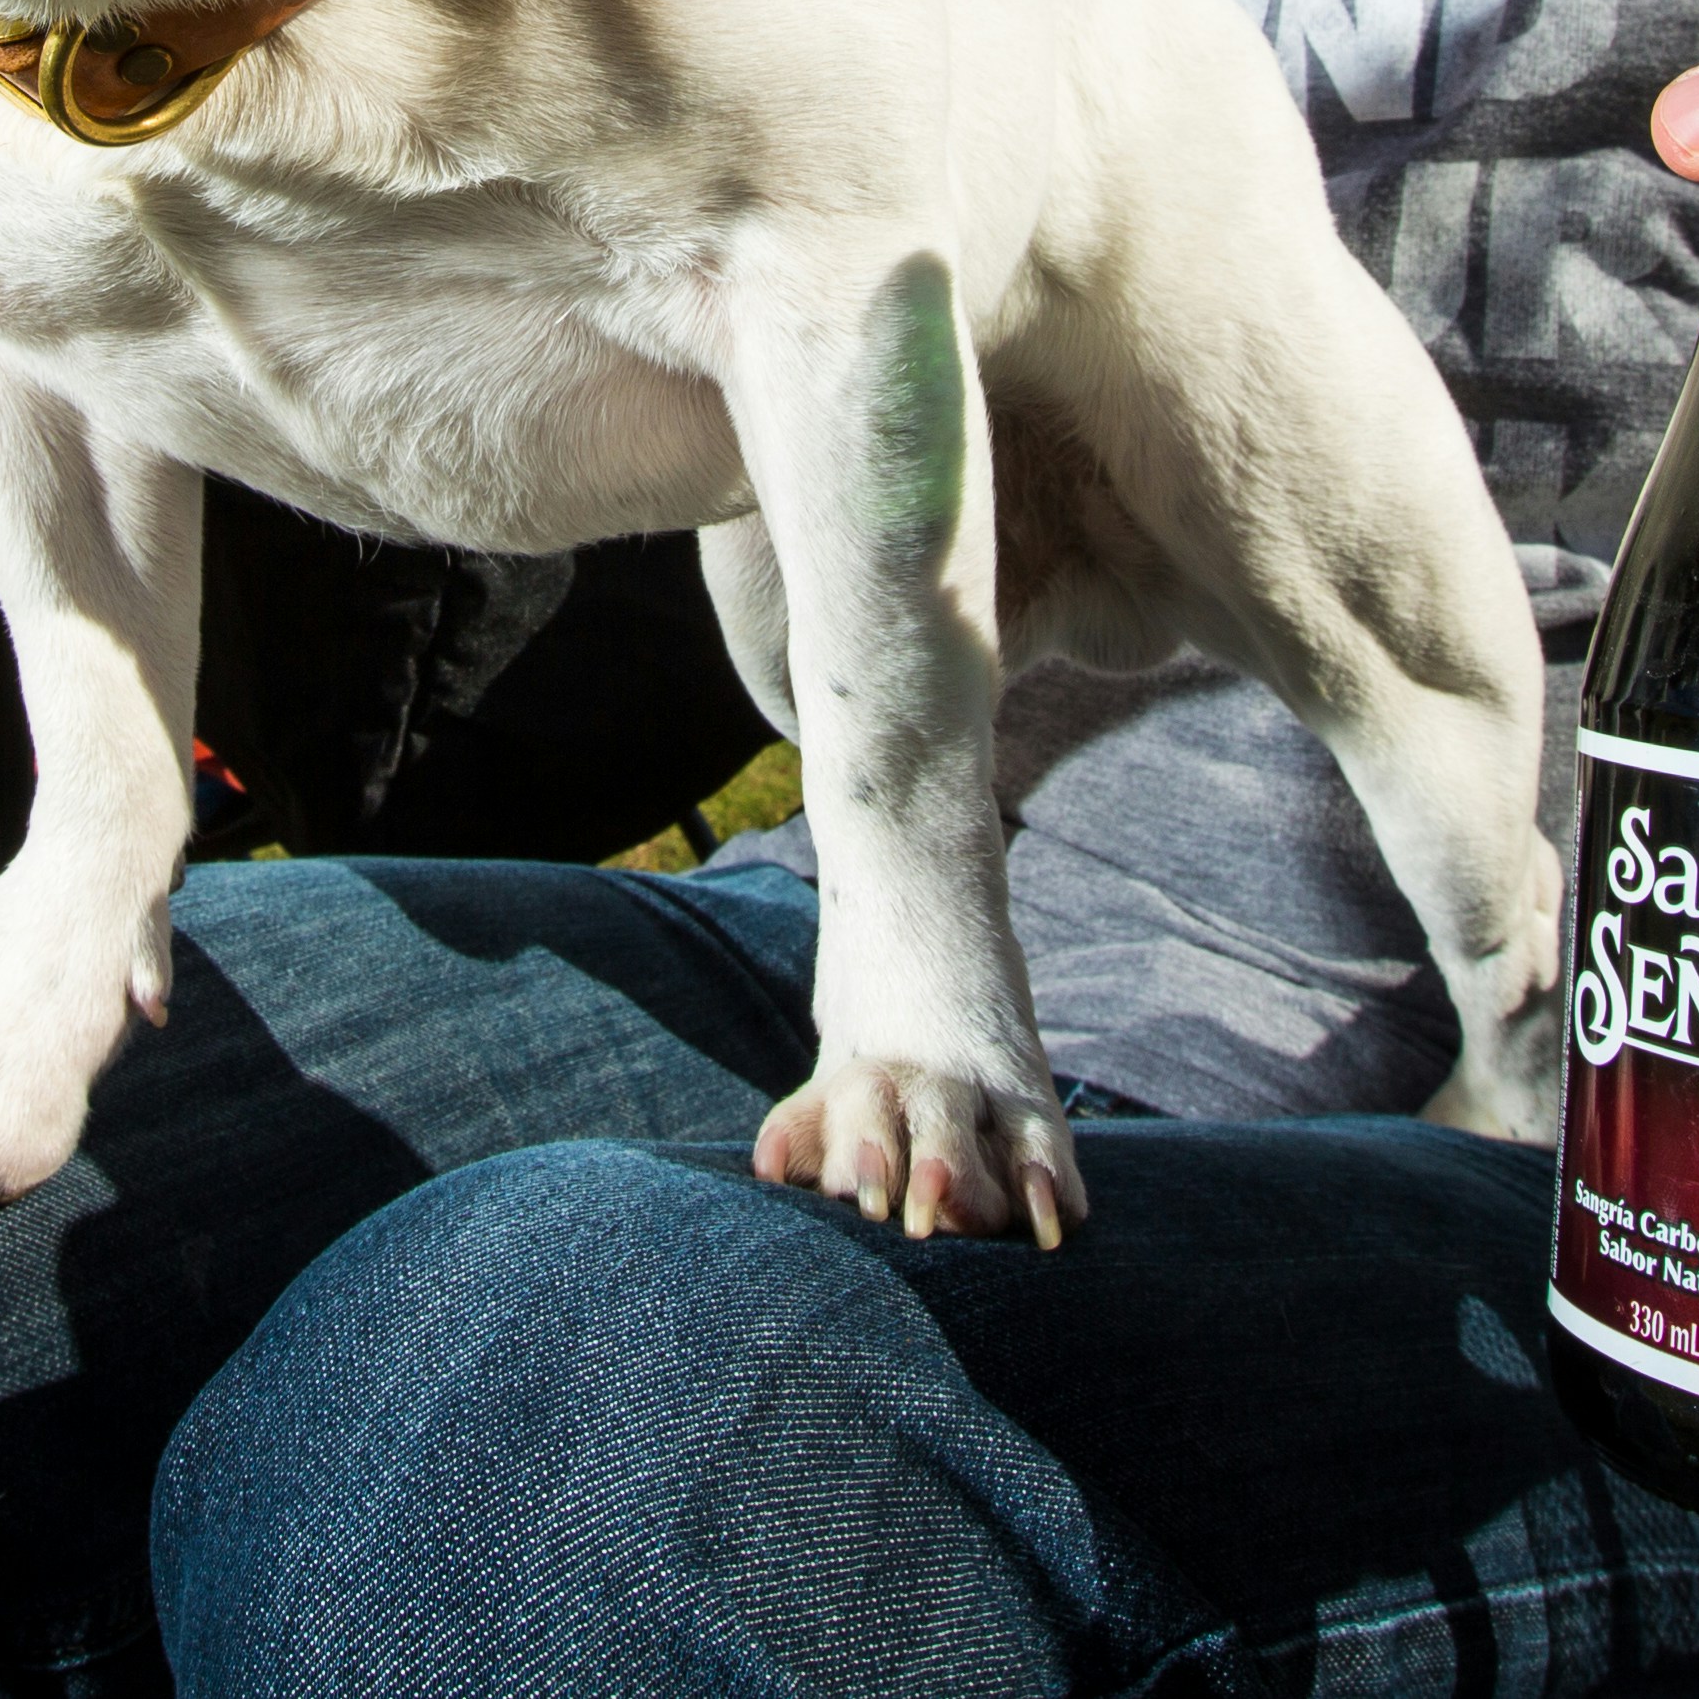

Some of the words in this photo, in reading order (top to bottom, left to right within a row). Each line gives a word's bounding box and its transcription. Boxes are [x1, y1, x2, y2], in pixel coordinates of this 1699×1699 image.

[1575, 1179, 1635, 1231] Sangría
[1599, 1229, 1657, 1276] Sabor
[1629, 1300, 1665, 1343] 330
